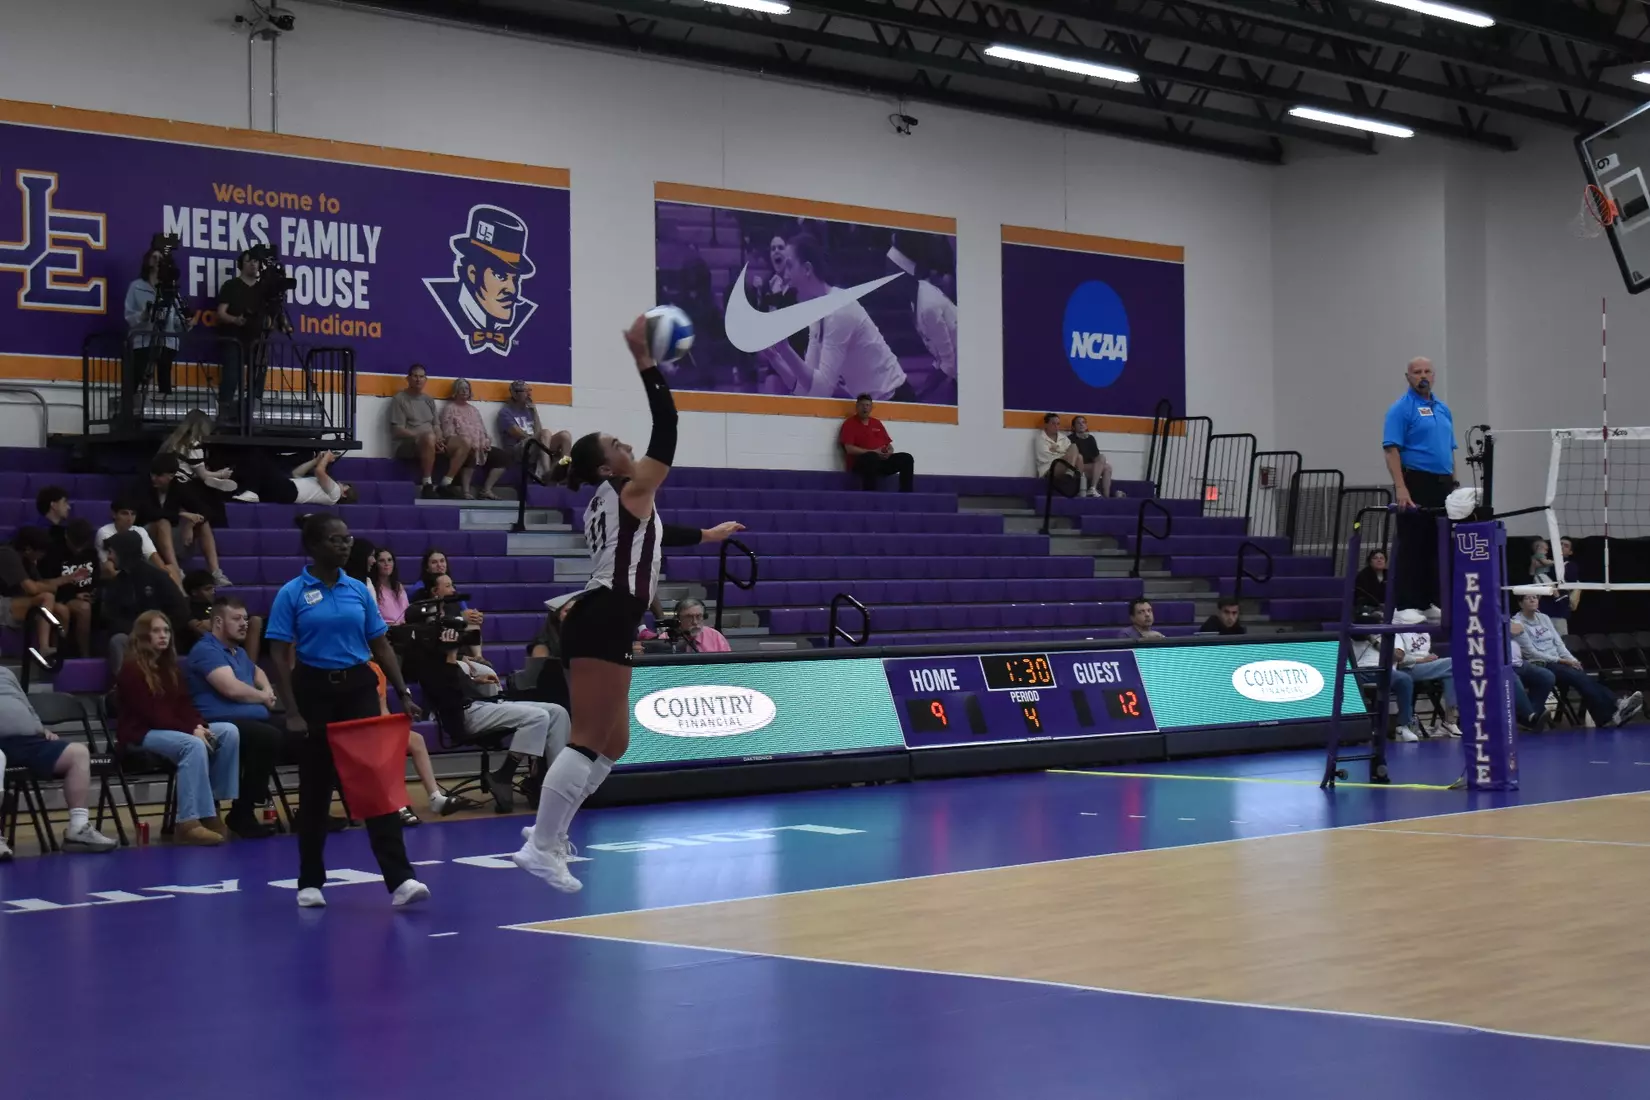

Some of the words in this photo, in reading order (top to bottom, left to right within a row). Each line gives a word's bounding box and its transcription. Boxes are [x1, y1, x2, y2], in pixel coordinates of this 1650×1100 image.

[212, 182, 313, 211] Welcome
[318, 192, 341, 214] to
[163, 205, 270, 252] MEEKS
[281, 216, 383, 265] FAMILY
[189, 256, 370, 310] FIEOUSE
[300, 313, 383, 339] Indiana
[1070, 331, 1128, 361] NCAA
[1457, 533, 1490, 560] UE
[909, 668, 961, 692] HOME
[1005, 658, 1051, 684] 1:30
[1072, 661, 1123, 685] GUEST
[1243, 668, 1309, 687] COUNTRY
[1464, 572, 1492, 784] EVANSVILLE
[653, 695, 754, 719] COUNTRY
[1009, 690, 1041, 703] PERIOD
[1118, 691, 1141, 717] 12
[678, 716, 743, 729] FINANCIAL
[930, 701, 948, 726] 9
[1024, 707, 1040, 728] 4
